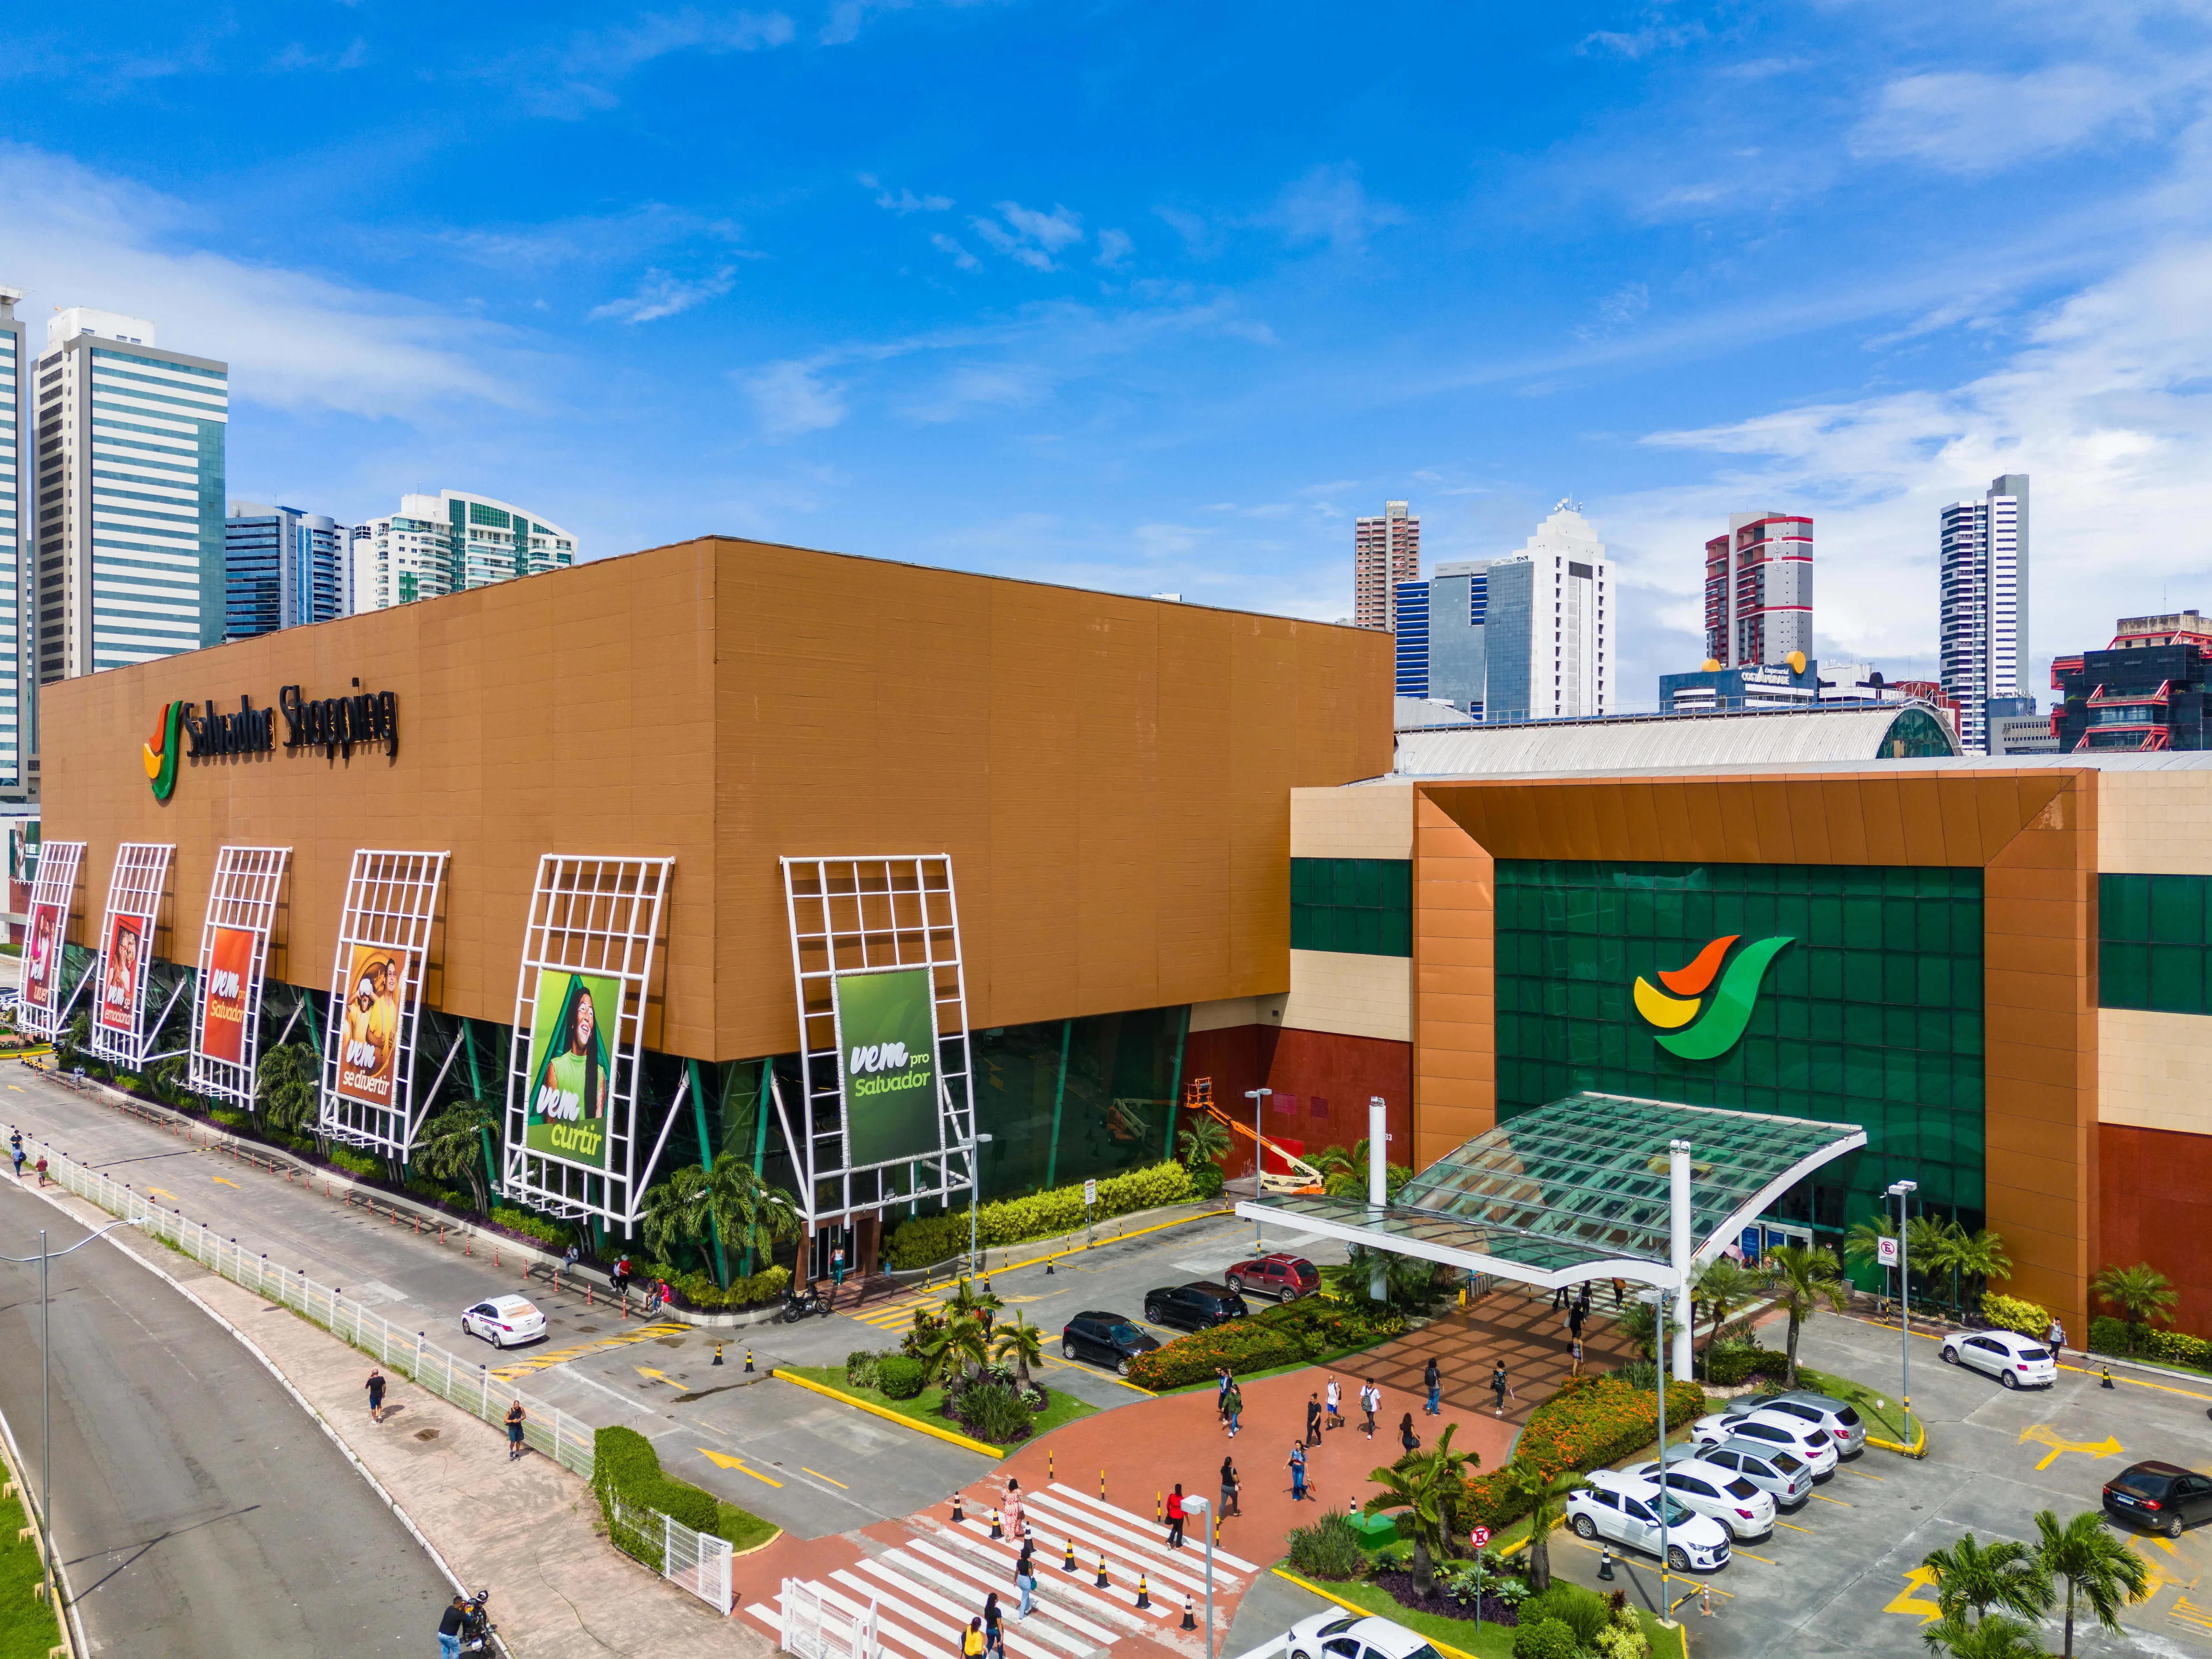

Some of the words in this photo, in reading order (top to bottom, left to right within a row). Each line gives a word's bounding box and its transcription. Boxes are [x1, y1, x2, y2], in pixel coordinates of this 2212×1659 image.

[183, 694, 274, 757] Salvador
[279, 677, 399, 760] Shopping
[34, 982, 48, 1002] viver
[107, 984, 125, 1006] vem
[124, 998, 130, 1010] se
[211, 968, 239, 998] vem
[210, 1000, 244, 1023] Salvador
[346, 1039, 376, 1069] vem
[850, 1041, 909, 1075] vem
[910, 1053, 930, 1068] pro
[343, 1070, 354, 1086] se
[354, 1070, 390, 1096] divertir
[855, 1070, 931, 1097] Salvador
[536, 1085, 581, 1122] vem
[551, 1124, 602, 1156] curtir
